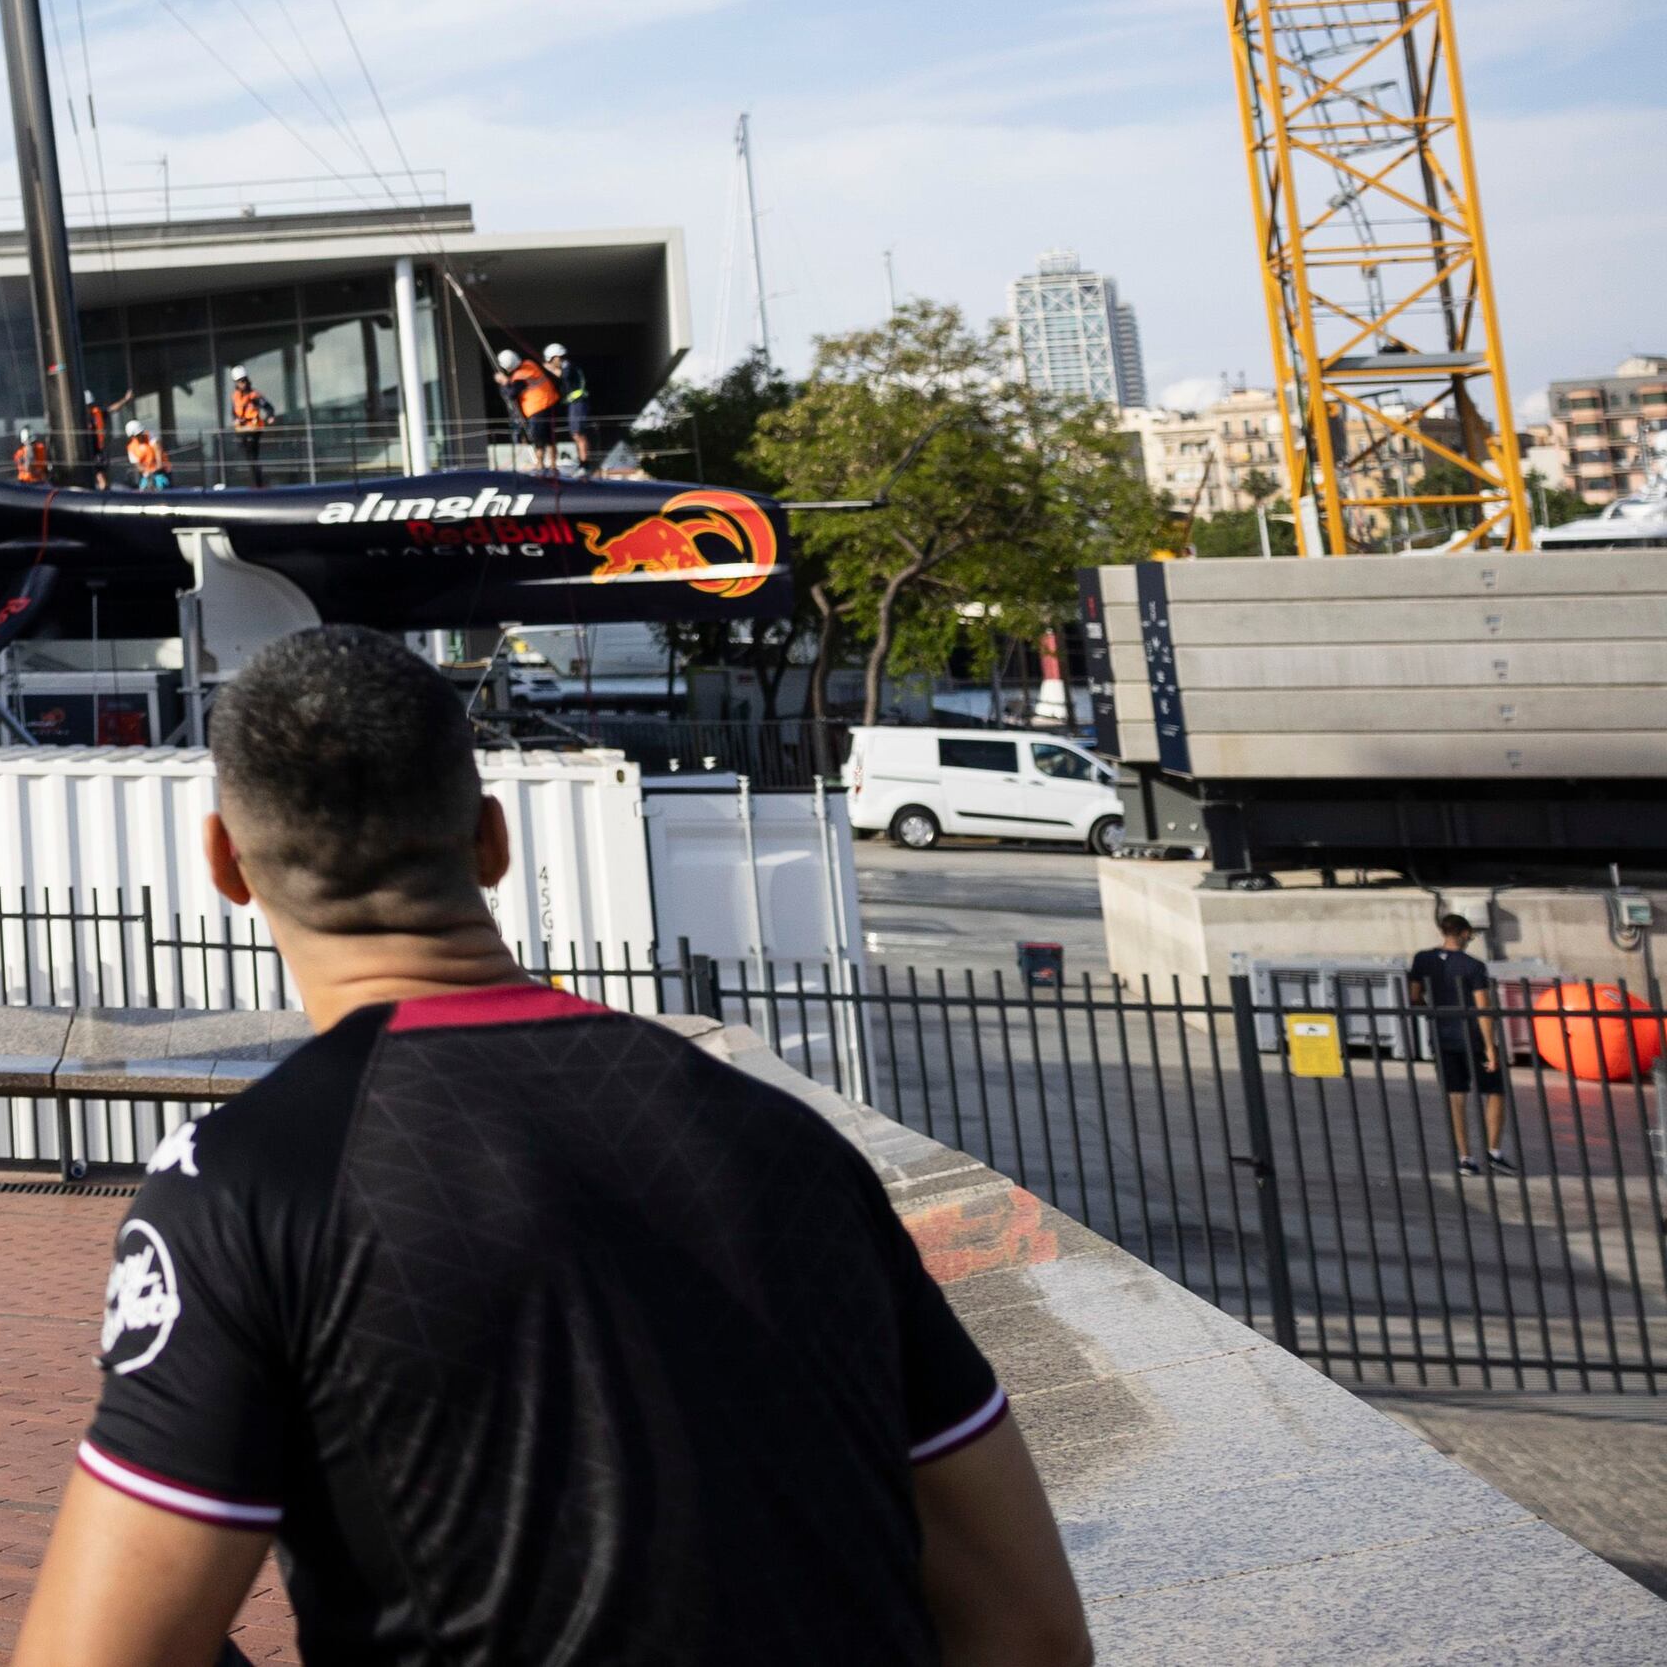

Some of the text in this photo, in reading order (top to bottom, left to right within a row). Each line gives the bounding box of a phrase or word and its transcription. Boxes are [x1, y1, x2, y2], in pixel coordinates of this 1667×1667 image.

[317, 487, 535, 524] alinghi
[405, 514, 575, 545] Red Bull
[367, 543, 545, 558] RACING
